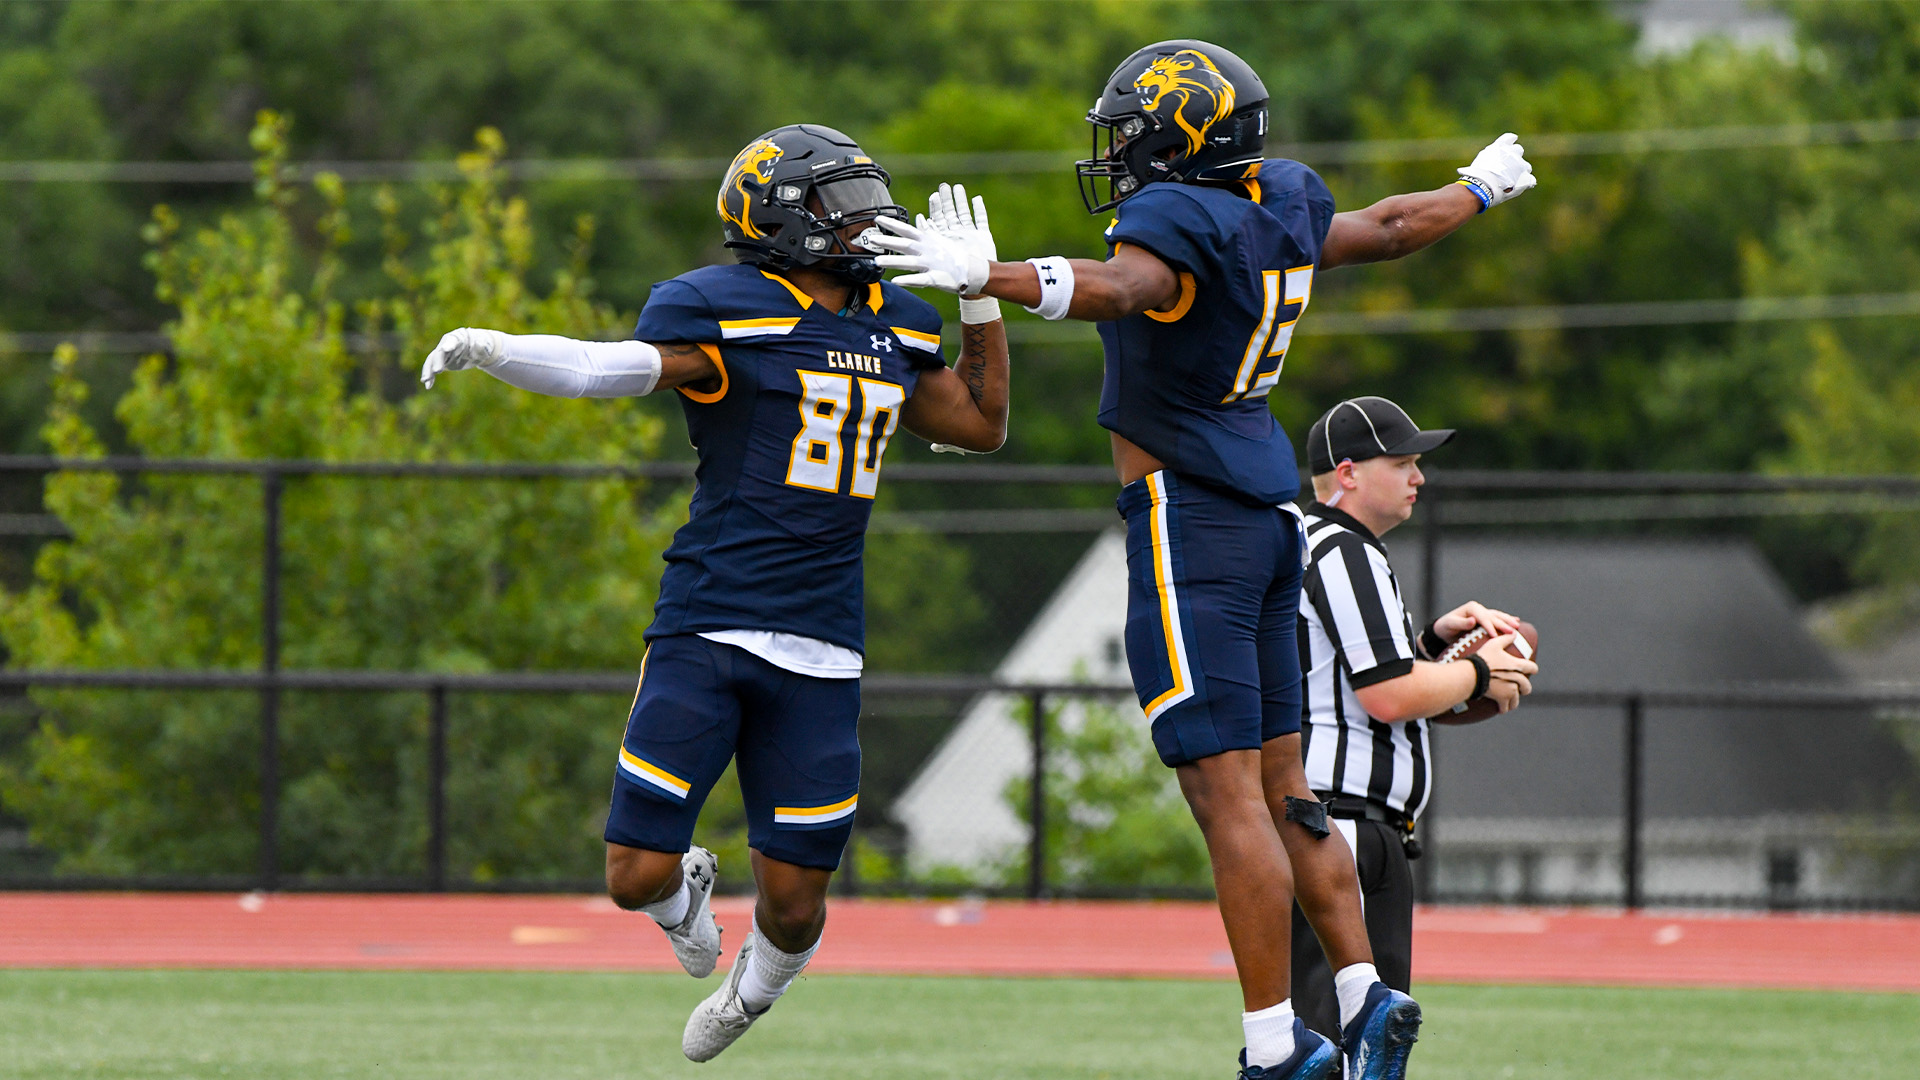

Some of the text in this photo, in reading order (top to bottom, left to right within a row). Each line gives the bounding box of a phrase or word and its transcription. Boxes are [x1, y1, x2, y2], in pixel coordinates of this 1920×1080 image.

[826, 350, 882, 374] CLARKE
[968, 322, 987, 400] MCMLXXX
[784, 369, 906, 500] 80
